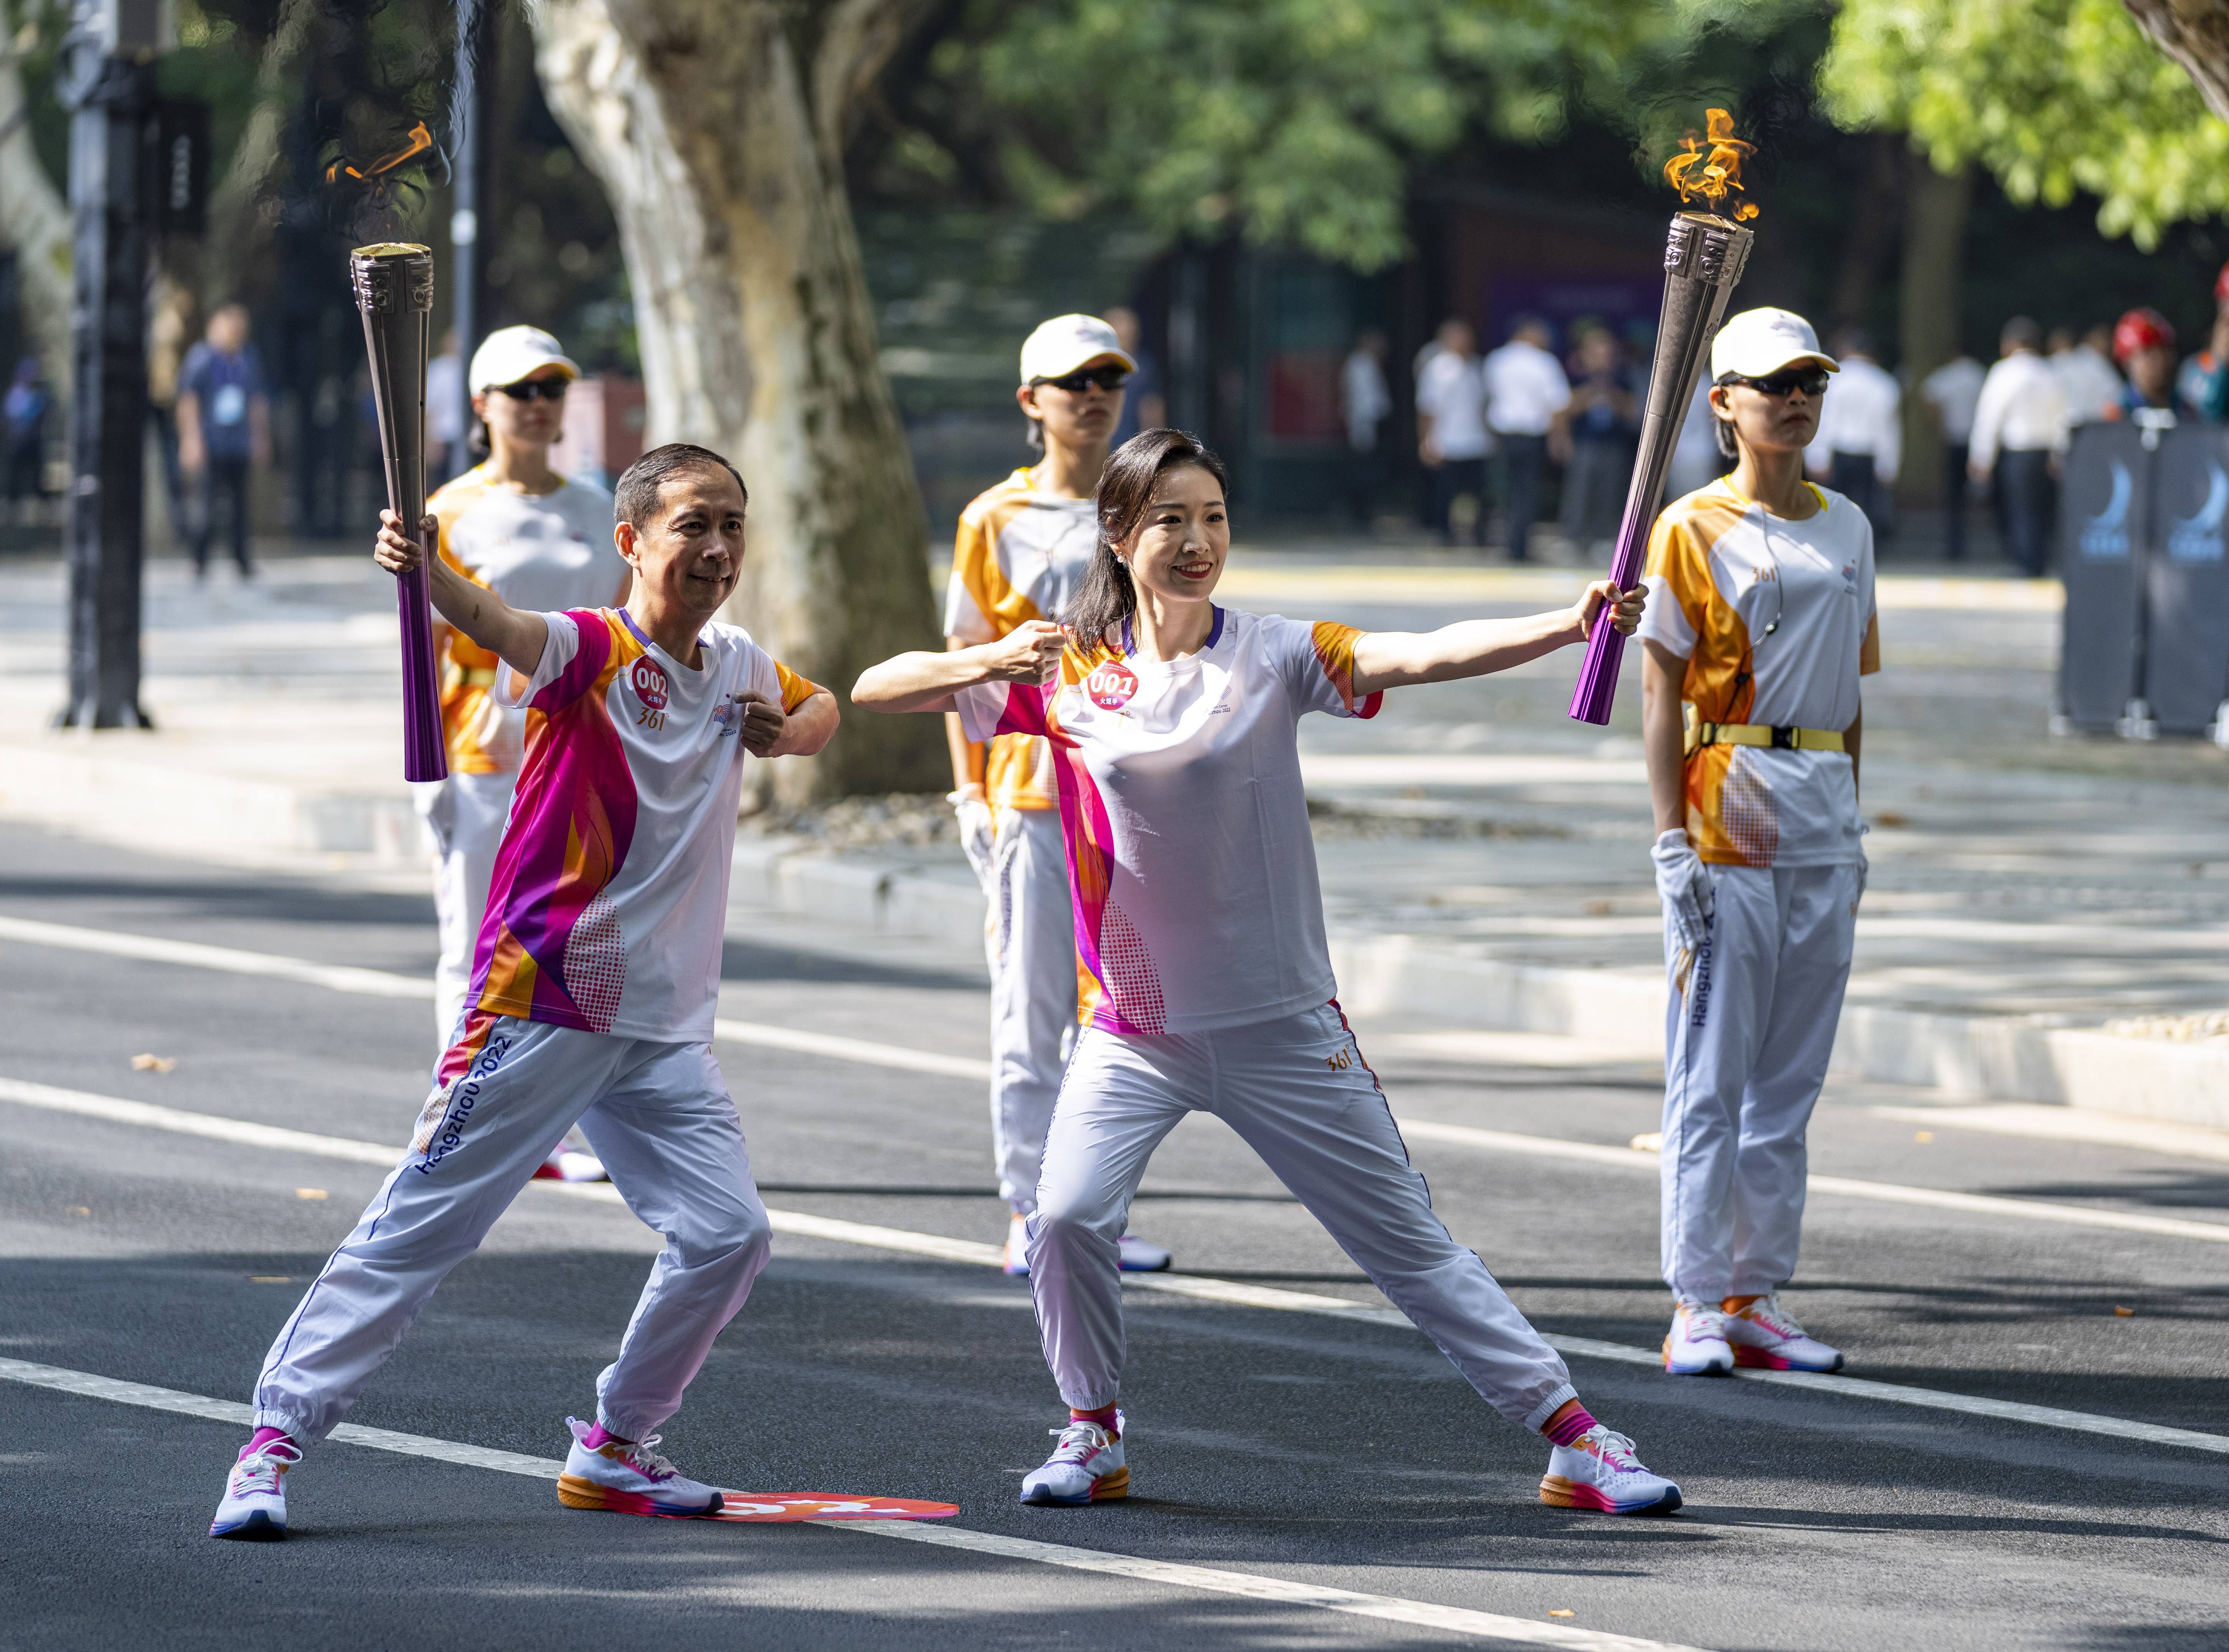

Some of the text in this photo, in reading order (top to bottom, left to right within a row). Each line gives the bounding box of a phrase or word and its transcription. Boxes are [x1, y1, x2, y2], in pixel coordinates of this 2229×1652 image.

[637, 667, 667, 698] 002
[1090, 671, 1134, 696] 001
[647, 695, 663, 704] 火炬手
[1100, 697, 1118, 705] 火炬手
[414, 1036, 512, 1175] Hangzhou 2022
